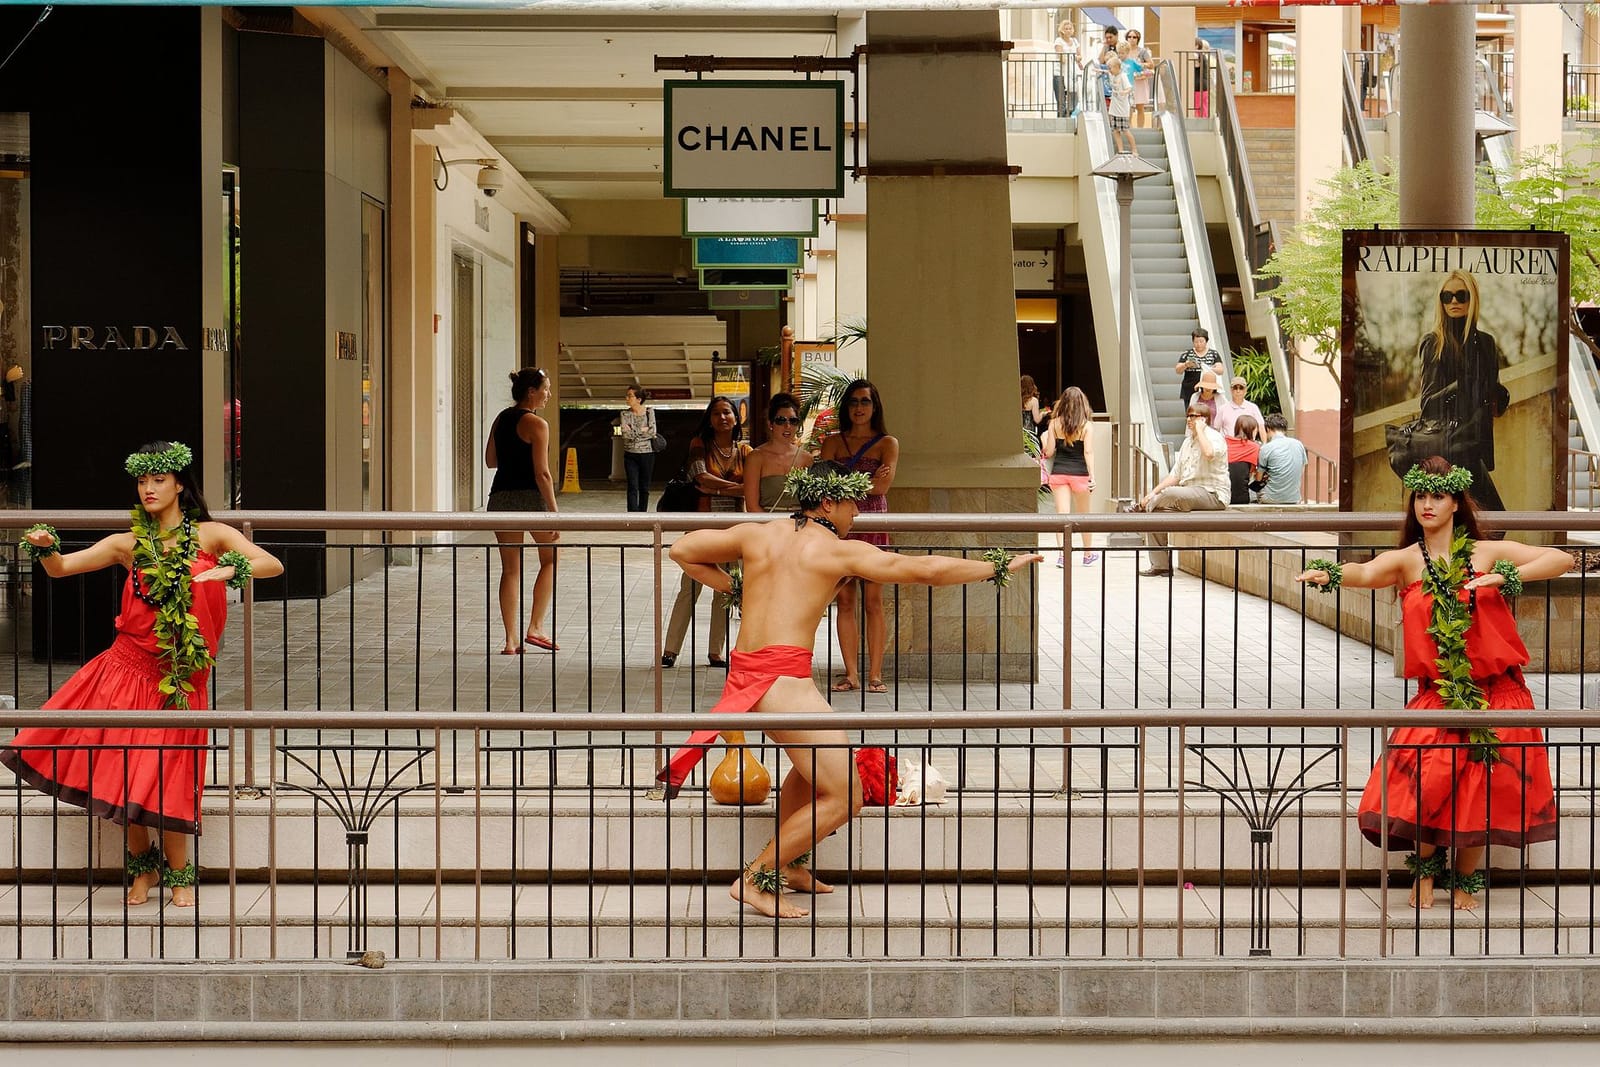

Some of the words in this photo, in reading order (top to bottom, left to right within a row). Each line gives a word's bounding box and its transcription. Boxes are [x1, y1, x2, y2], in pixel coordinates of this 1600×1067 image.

[677, 125, 832, 151] CHANEL
[1356, 245, 1450, 273] RALPH
[1458, 247, 1558, 275] LAUREN
[42, 325, 189, 351] PRADA
[804, 352, 832, 362] BAU
